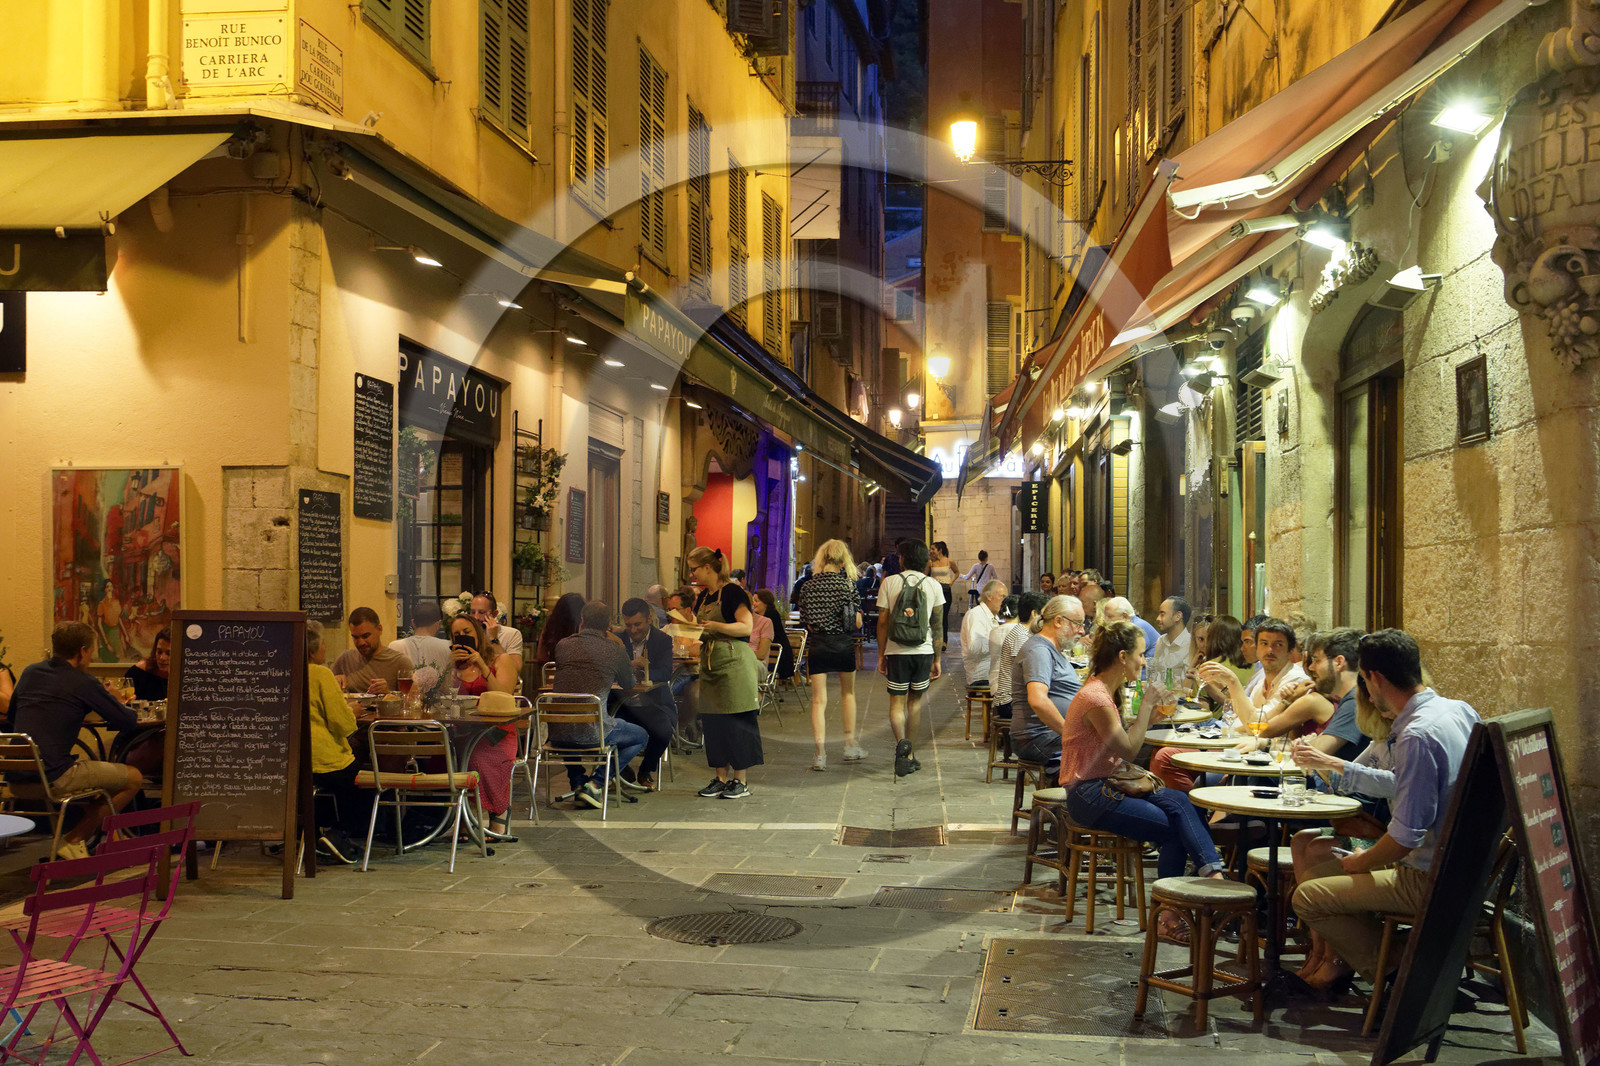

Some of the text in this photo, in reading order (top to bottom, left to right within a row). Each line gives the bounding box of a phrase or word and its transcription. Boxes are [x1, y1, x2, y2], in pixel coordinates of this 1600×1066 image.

[221, 23, 246, 34] RUE
[235, 35, 281, 47] BUNICO
[302, 39, 309, 52] DE
[309, 45, 316, 58] LA
[317, 37, 328, 53] RUE
[199, 53, 268, 66] CARRIERA
[202, 66, 265, 79] DE L'ARC
[309, 62, 335, 88] CARRIERA
[643, 303, 692, 361] PAPAYOU
[398, 351, 498, 418] PAPAYOU
[1030, 483, 1039, 531] EPICERIE
[218, 624, 265, 640] PAPAYOU
